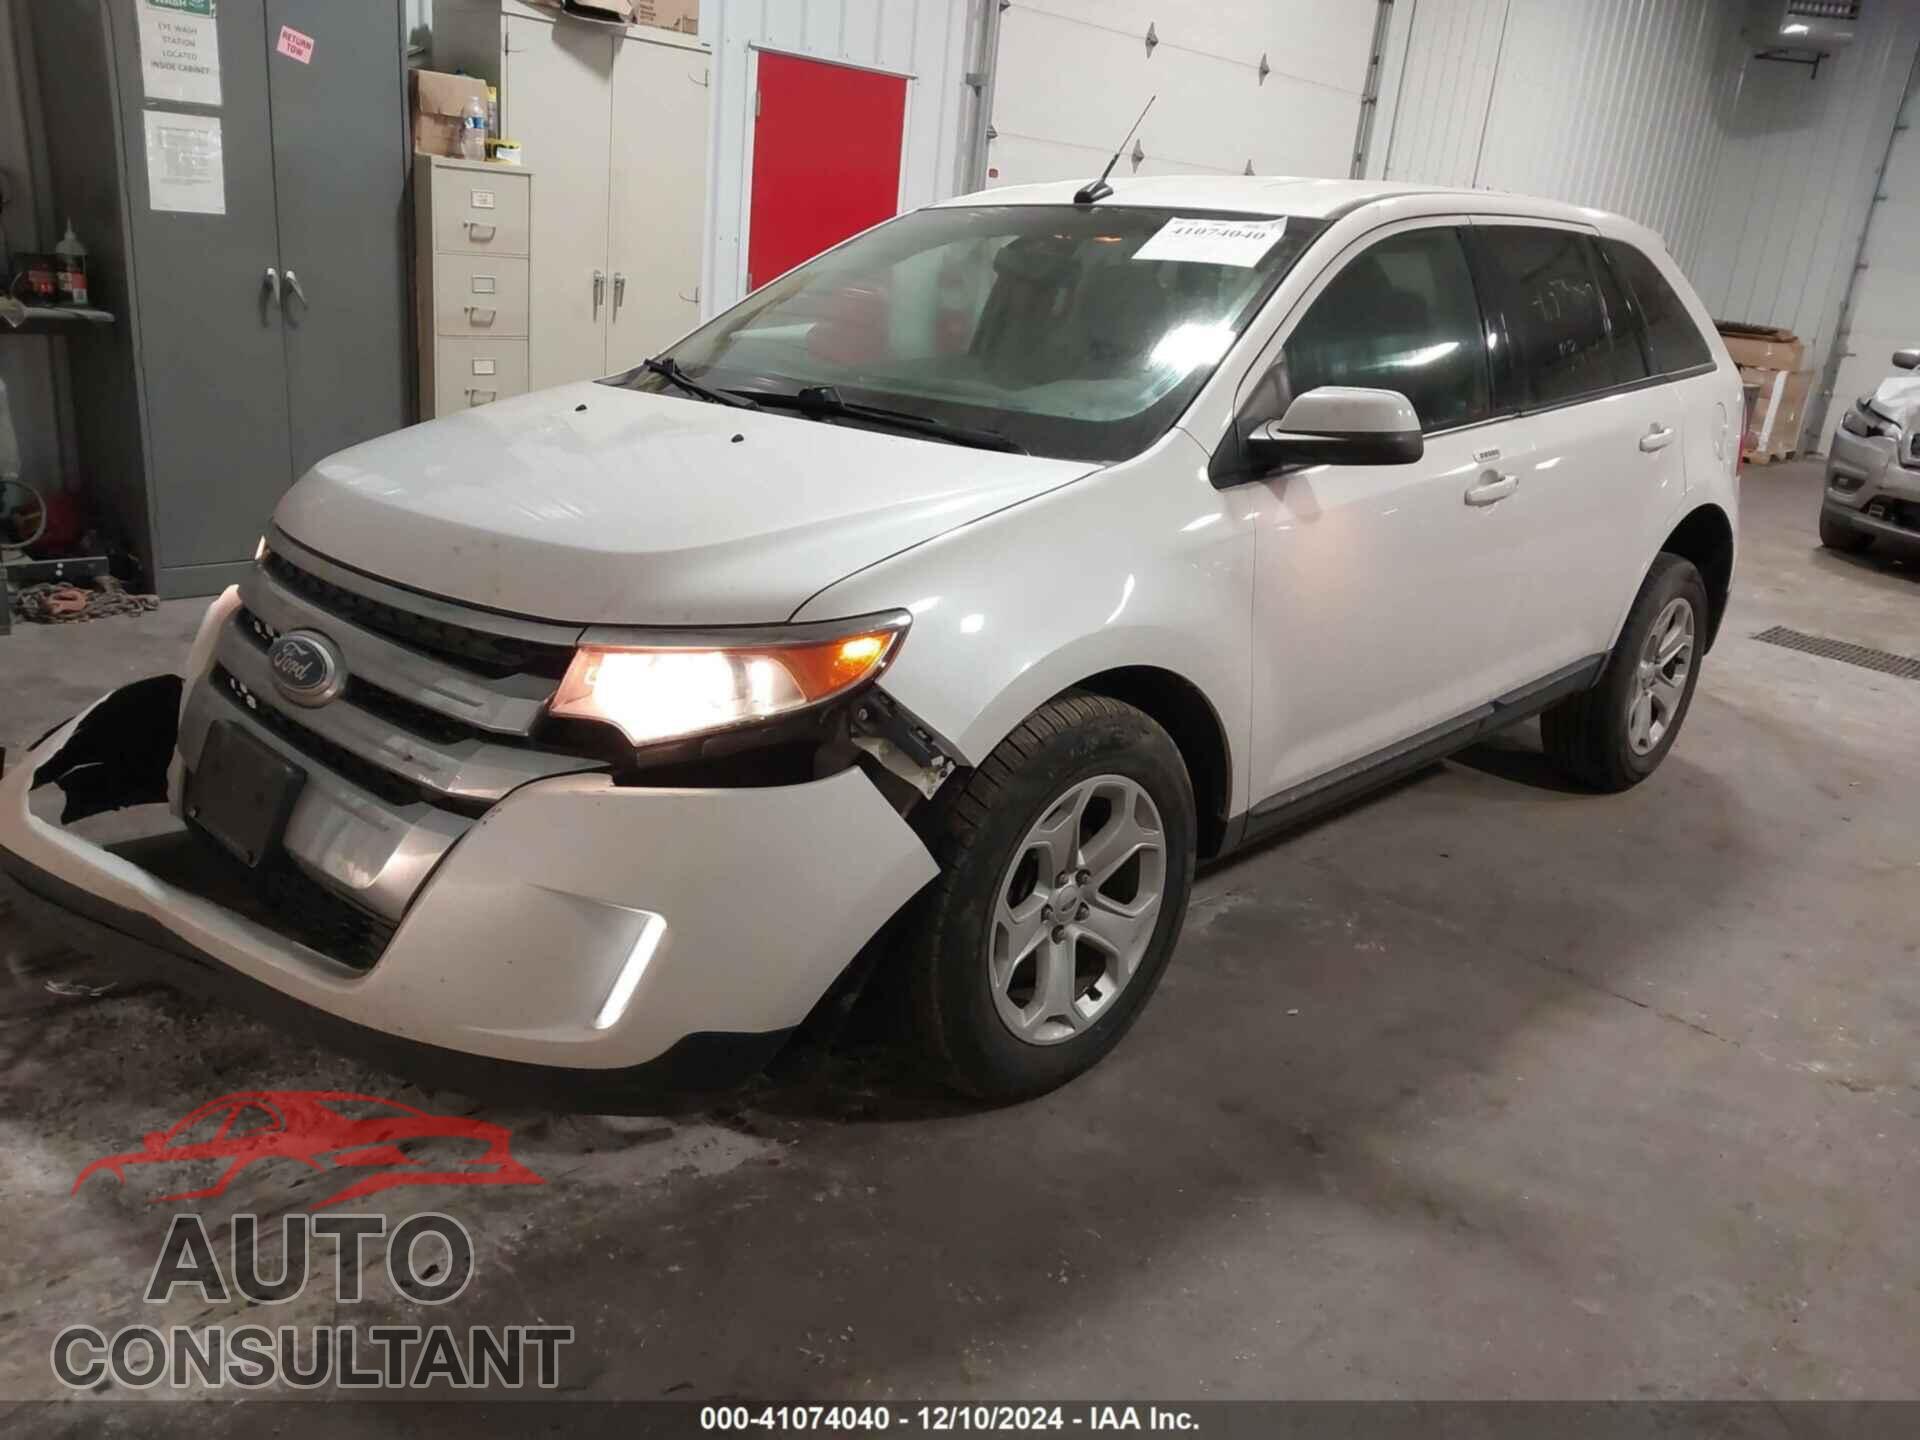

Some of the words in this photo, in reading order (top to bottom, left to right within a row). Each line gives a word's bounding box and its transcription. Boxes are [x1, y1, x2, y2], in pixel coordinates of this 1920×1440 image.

[162, 35, 196, 47] STATION
[282, 31, 312, 50] RETURN
[162, 50, 198, 61] LOCATED
[286, 42, 304, 56] TOW
[151, 60, 176, 71] INSIDE
[177, 63, 210, 75] CABINET
[1172, 226, 1267, 241] 41074040
[273, 641, 313, 681] Ford
